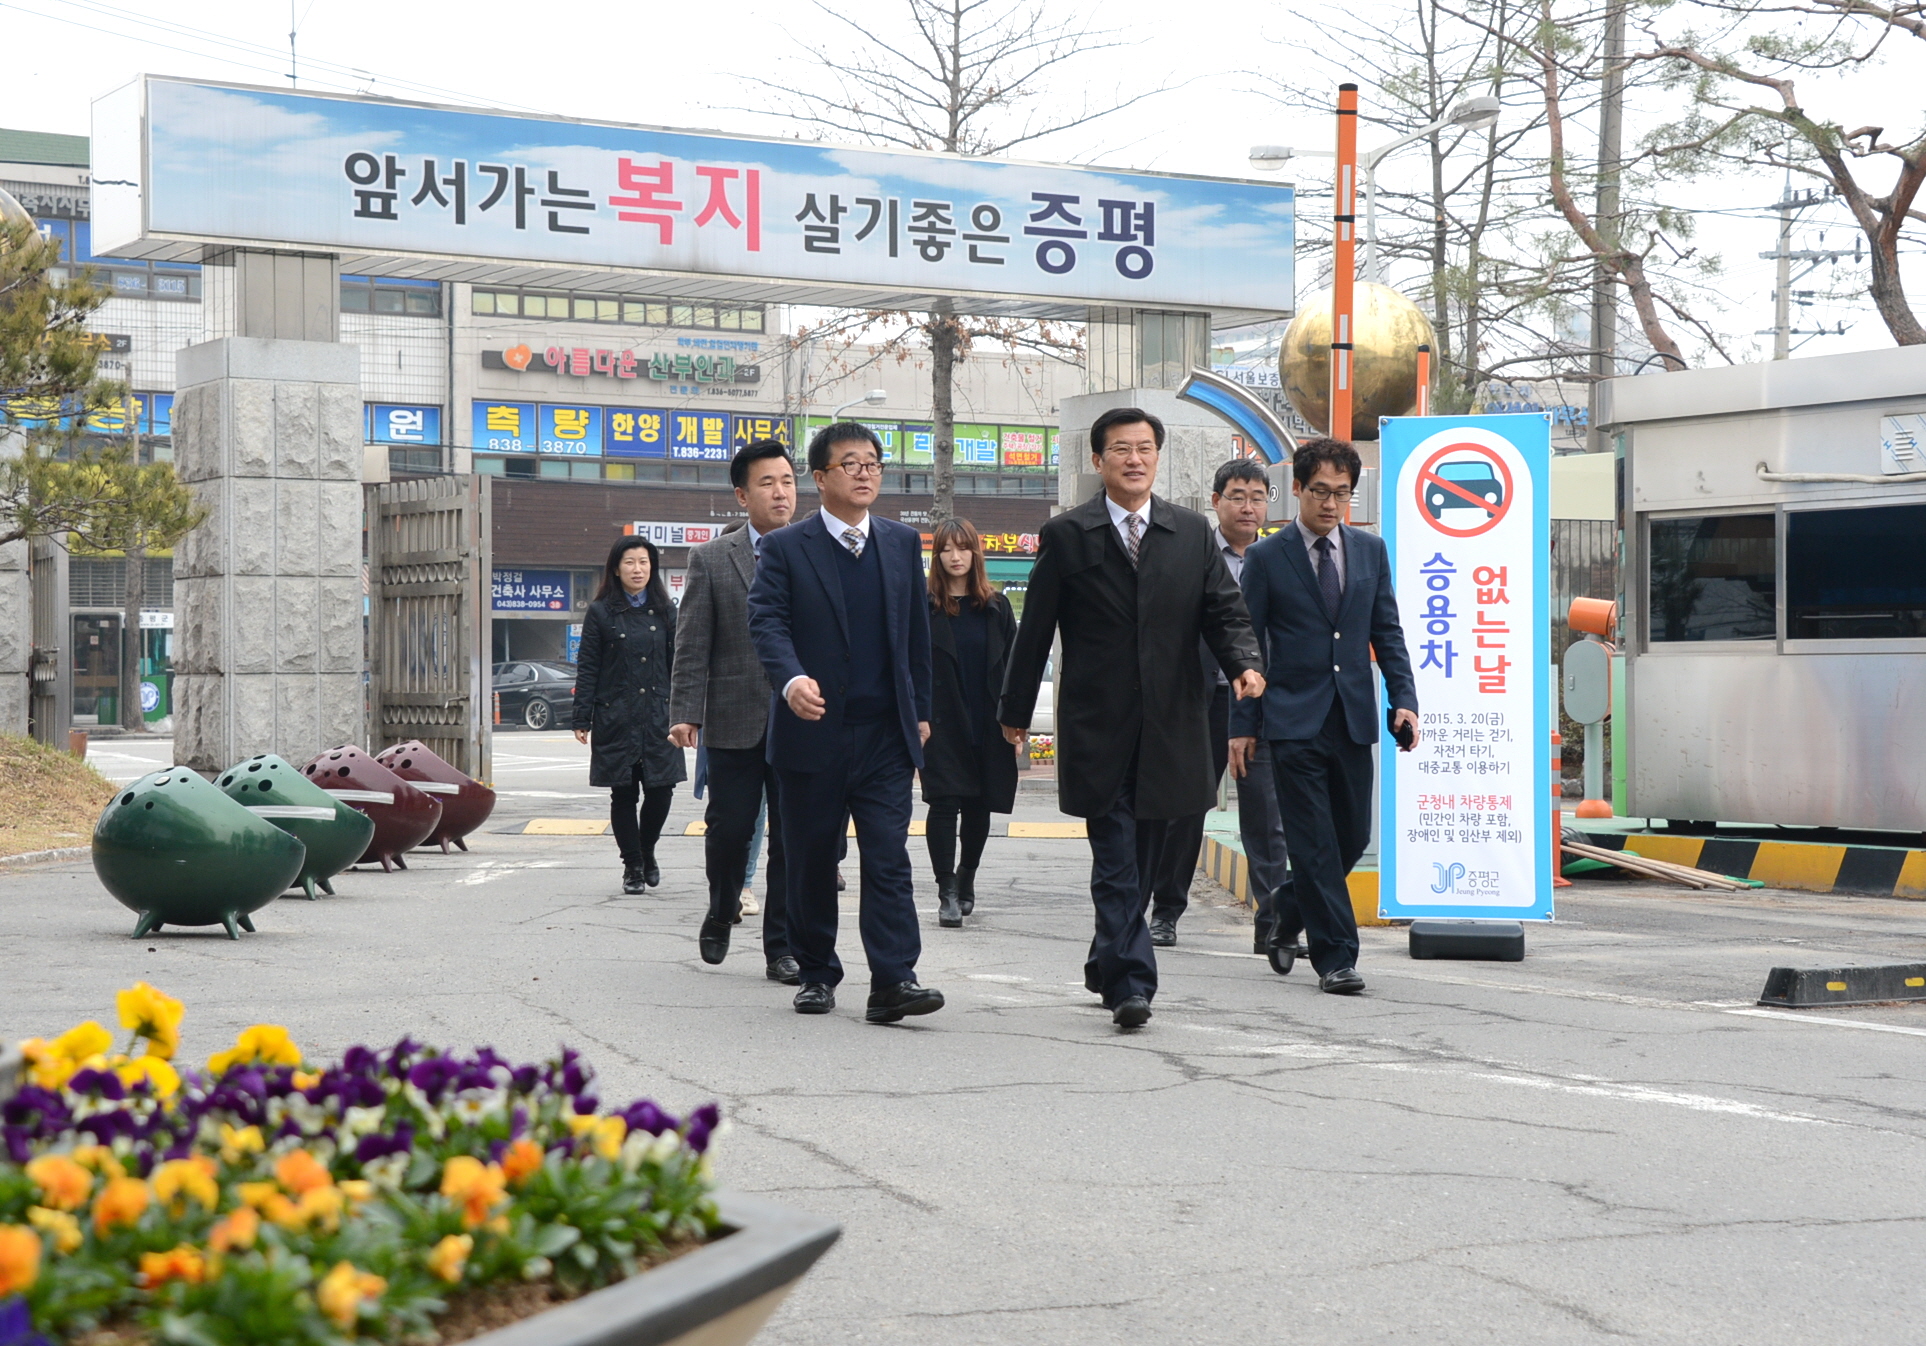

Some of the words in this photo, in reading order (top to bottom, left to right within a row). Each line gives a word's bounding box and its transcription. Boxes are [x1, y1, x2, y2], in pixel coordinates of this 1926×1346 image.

[344, 151, 597, 235] 앞서가는
[608, 157, 761, 252] 복지
[794, 192, 1011, 266] 살기좋은
[1023, 191, 1155, 280] 증평
[116, 339, 127, 348] 2F
[543, 346, 638, 379] 아름다운
[648, 351, 737, 384] 산부인과
[743, 368, 755, 377] 2F
[389, 409, 423, 441] 원
[611, 412, 661, 443] 한양
[676, 415, 724, 446] 개발
[735, 418, 791, 445] 사무소
[672, 446, 728, 460] T.836-2231
[955, 439, 998, 462] 개발
[638, 525, 684, 544] 터미널
[491, 584, 526, 598] 건축사
[529, 585, 565, 598] 사무소
[497, 600, 546, 609] 043)838-0954
[1418, 552, 1458, 679] 승용차
[1423, 713, 1453, 725] 2015.
[1456, 713, 1467, 725] 3.
[1471, 712, 1504, 726] 20(금)
[1452, 728, 1485, 742] 거리는
[1488, 728, 1513, 742] 걷기,
[1433, 744, 1465, 758] 자전거
[1469, 744, 1495, 759] 타기,
[1418, 761, 1462, 775] 대중교통
[1466, 761, 1510, 775] 이용하기
[1417, 794, 1455, 810] 군청내
[1460, 794, 1512, 811] 차량통제
[1419, 812, 1455, 827] (민간인
[1459, 813, 1482, 827] 차량
[1485, 813, 1511, 828] 포함,
[1407, 829, 1440, 843] 장애인
[1444, 829, 1455, 843] 및
[1458, 829, 1492, 843] 임산부
[1496, 829, 1522, 844] 제외)
[1468, 870, 1500, 888] 증평군
[1456, 888, 1475, 896] Jeung
[1476, 888, 1501, 897] Pyeong
